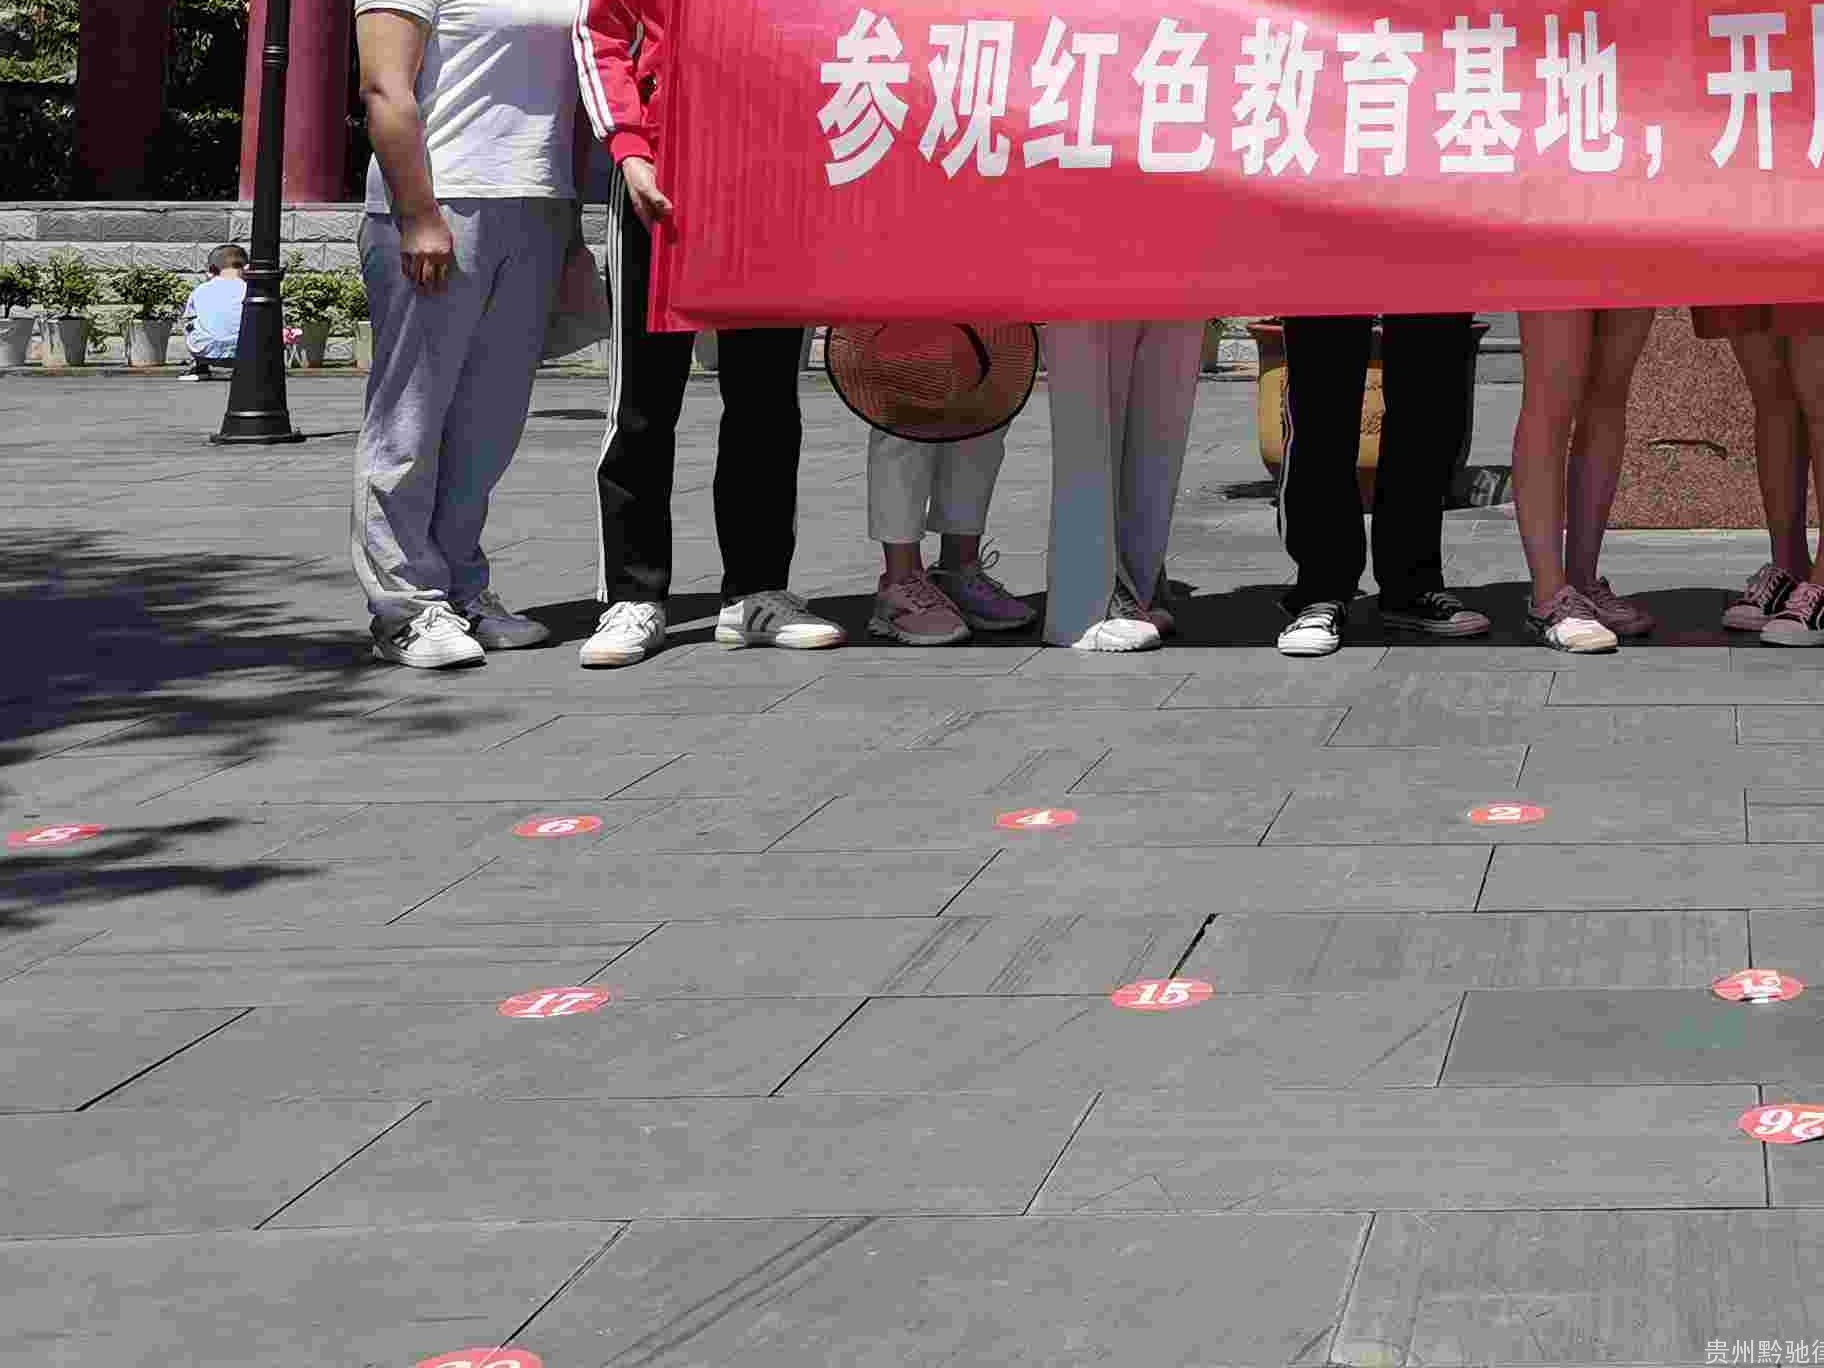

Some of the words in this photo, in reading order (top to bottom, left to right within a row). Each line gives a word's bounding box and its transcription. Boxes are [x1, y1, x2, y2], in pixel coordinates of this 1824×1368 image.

[1015, 810, 1056, 824] 4
[1486, 806, 1522, 820] 2
[536, 818, 580, 833] 6
[1137, 981, 1194, 1005] 15
